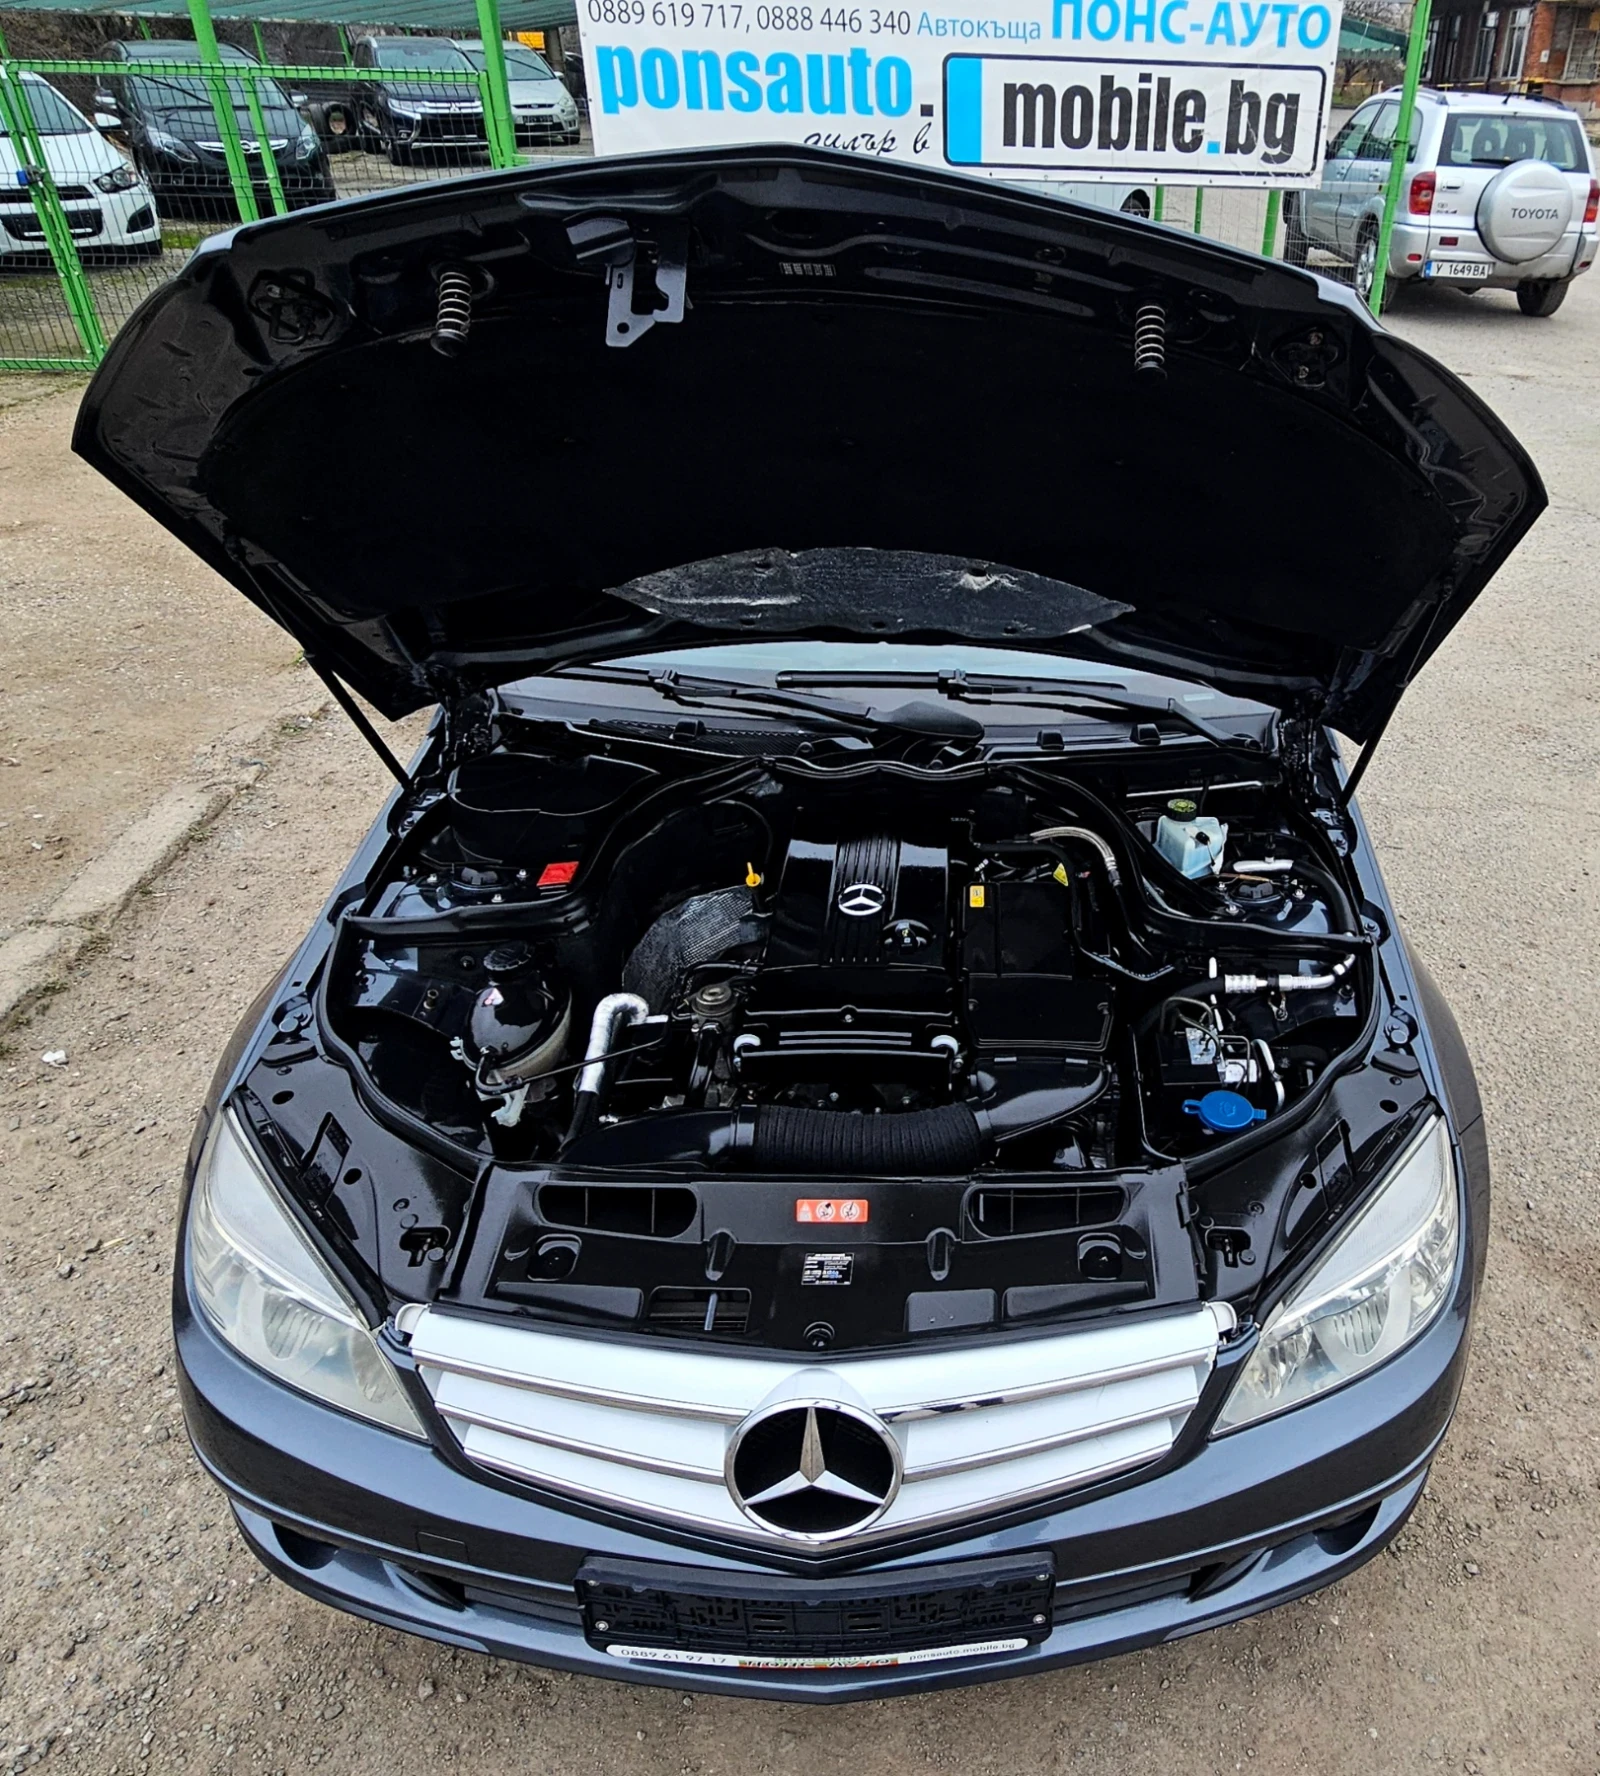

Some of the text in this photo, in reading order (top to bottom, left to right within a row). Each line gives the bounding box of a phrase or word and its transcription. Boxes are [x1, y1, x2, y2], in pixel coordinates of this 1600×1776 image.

[588, 0, 1331, 49] 0889 619 717, 0888 446 340 Автокъща ПОНС-АУТО
[1003, 73, 1301, 164] mobile.bg
[1511, 208, 1558, 219] TOYOTA
[621, 1649, 657, 1658] 0889
[909, 1643, 1015, 1660] ponsauto.mobile.bg
